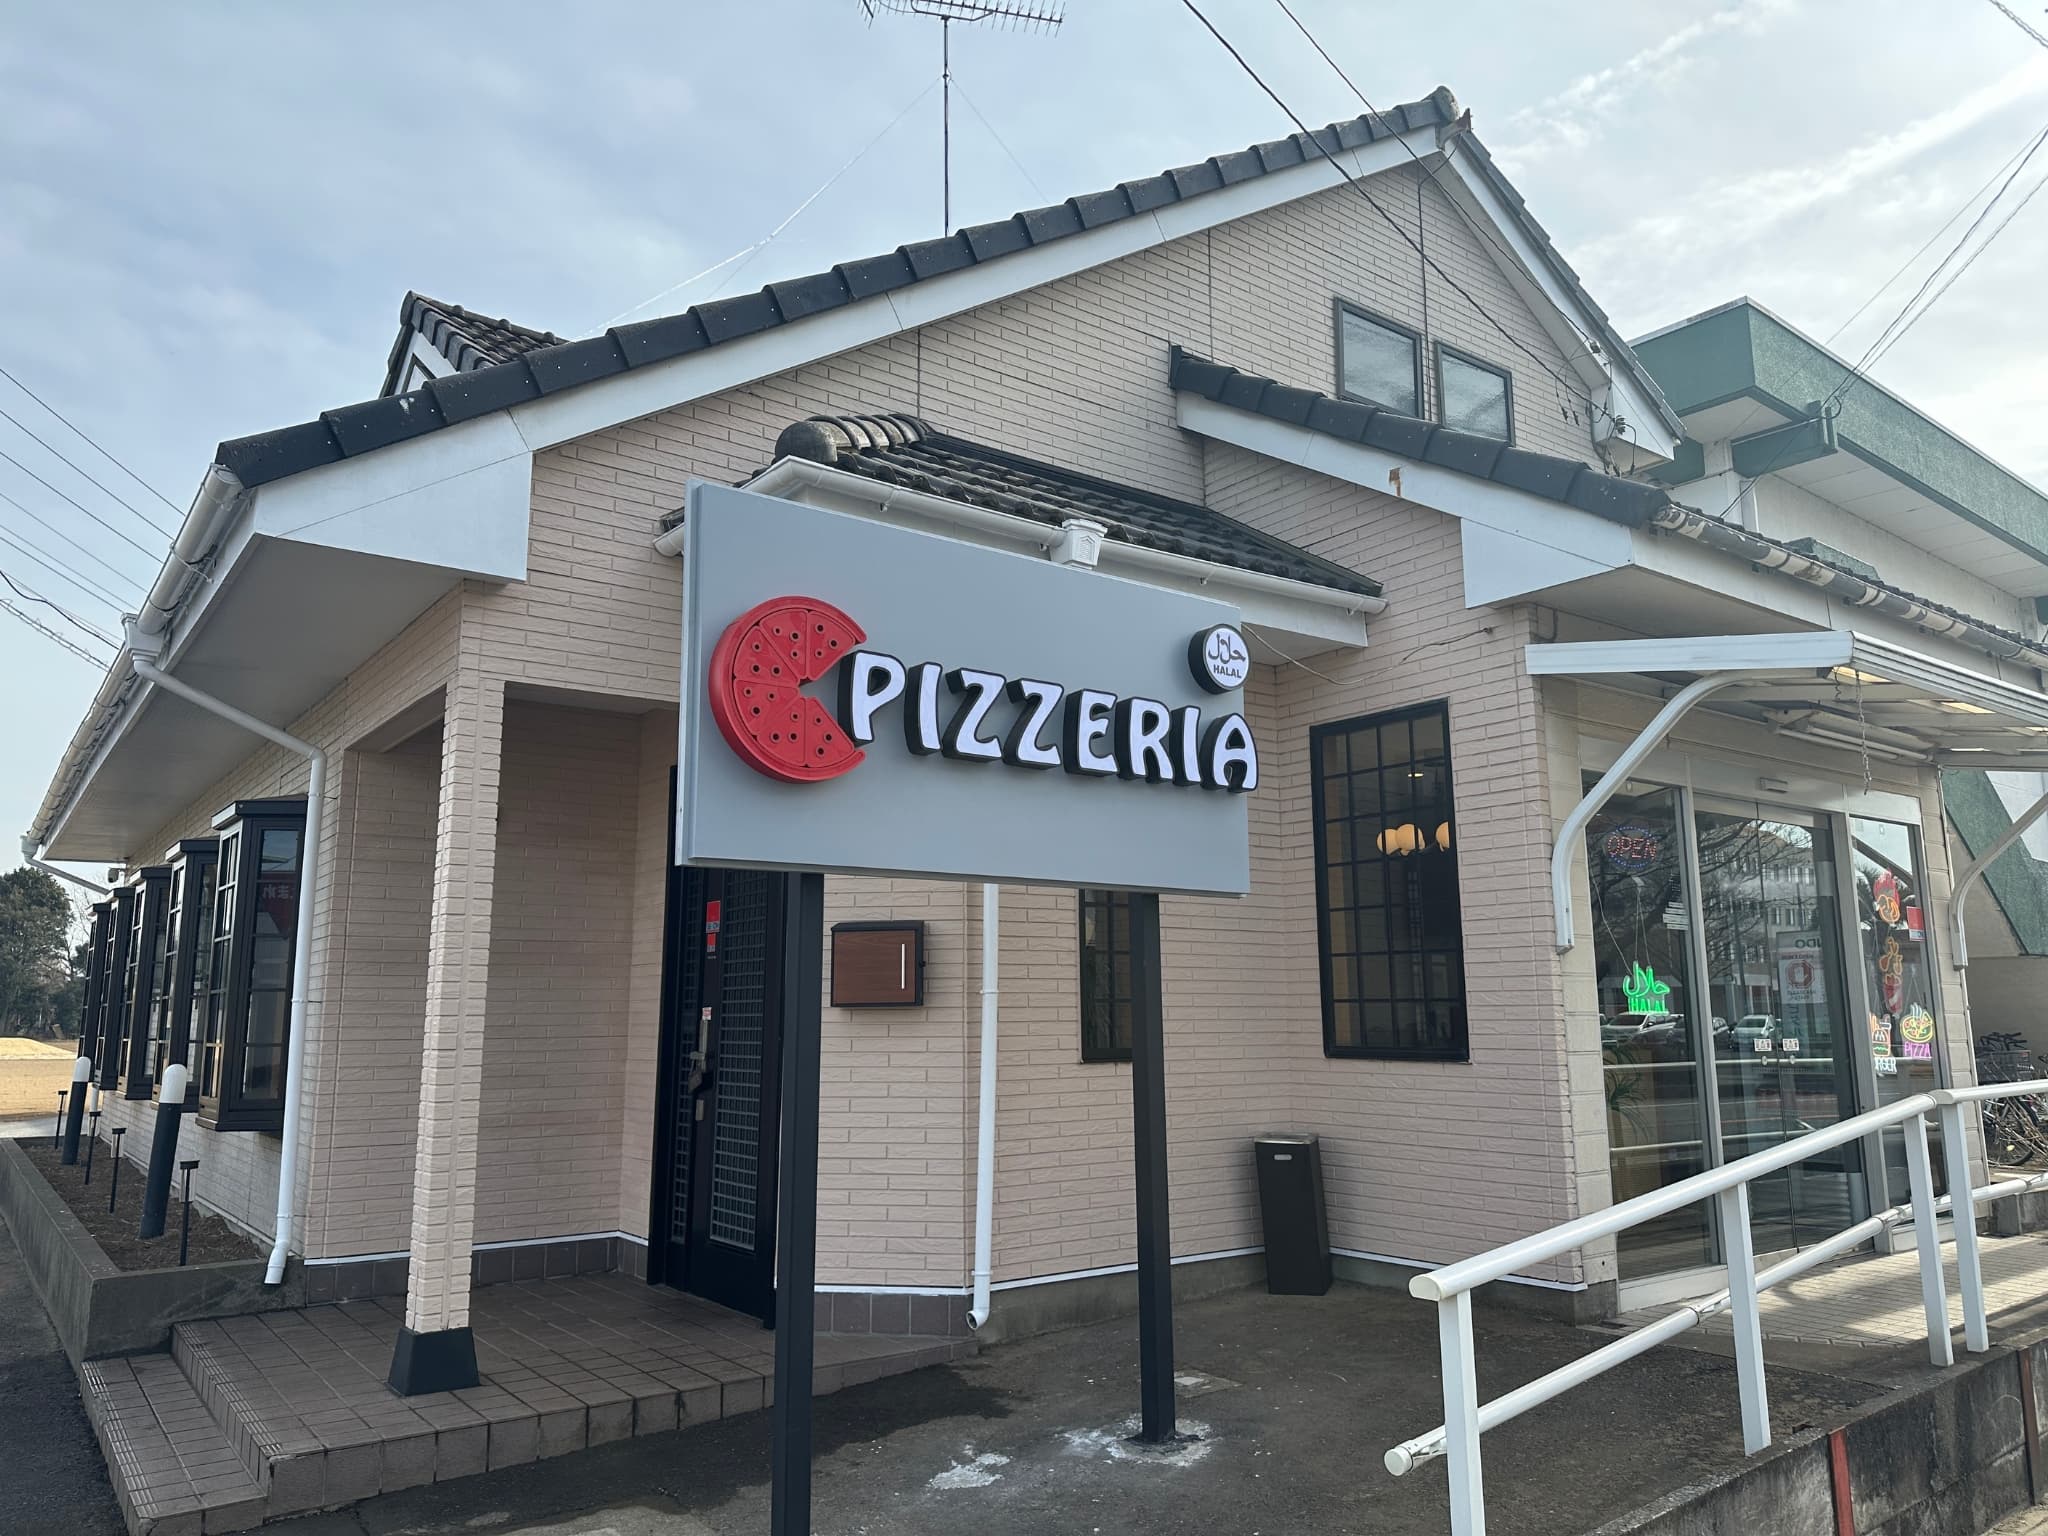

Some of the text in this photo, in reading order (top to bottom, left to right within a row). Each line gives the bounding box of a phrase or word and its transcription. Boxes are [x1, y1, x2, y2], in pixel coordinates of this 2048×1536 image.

[1208, 632, 1246, 664] حلال
[1213, 664, 1242, 679] HALAL
[840, 650, 1259, 793] PIZZERIA
[1608, 836, 1657, 861] OPEN
[1622, 960, 1670, 997] حلال
[1628, 997, 1669, 1015] HALAL
[1904, 1041, 1932, 1058] PIZZA
[1874, 1057, 1897, 1073] RGER
